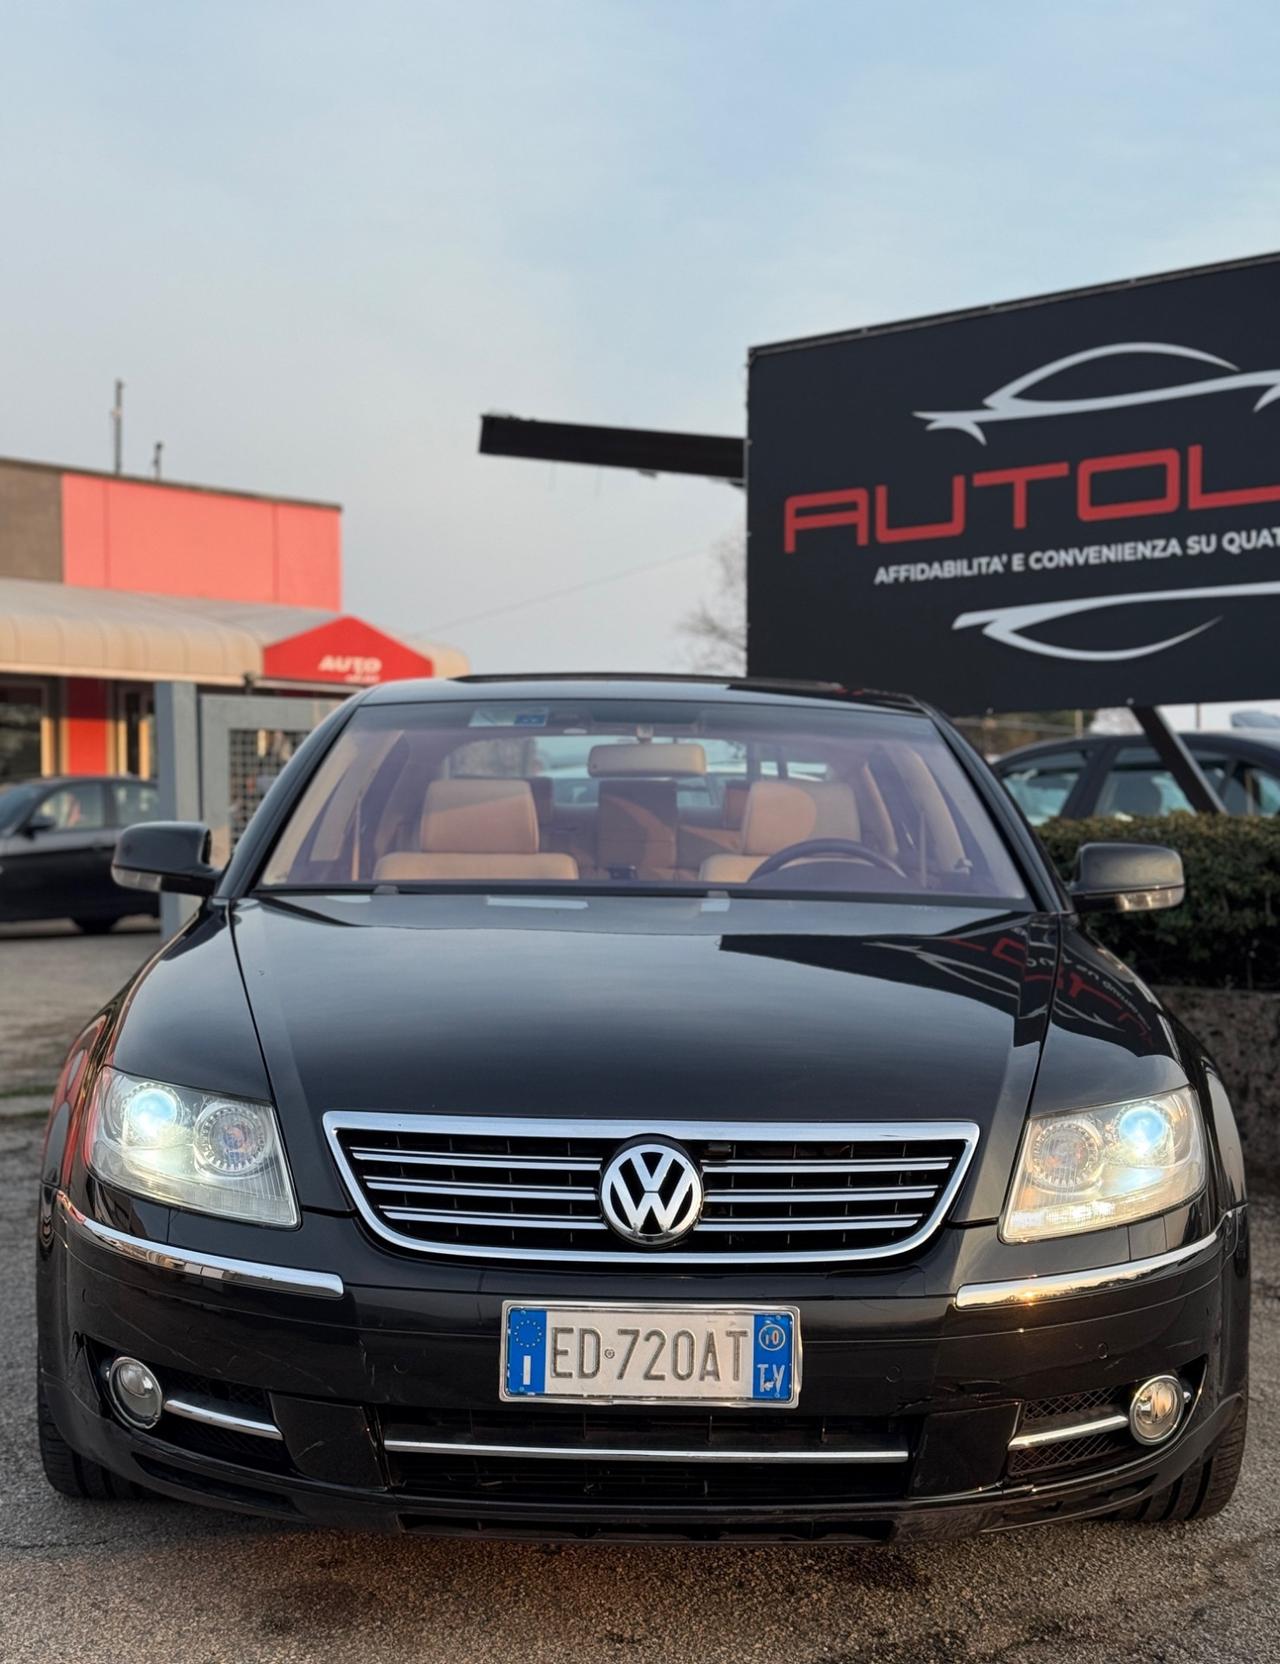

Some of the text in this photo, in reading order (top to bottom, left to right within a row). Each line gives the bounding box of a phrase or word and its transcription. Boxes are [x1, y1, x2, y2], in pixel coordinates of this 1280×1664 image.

[784, 444, 1280, 553] AUTOL
[873, 553, 1008, 585] AFFIDABILITA'
[1011, 553, 1025, 573] E
[1028, 537, 1183, 571] CONVENIENZA
[1186, 533, 1217, 555] SU
[317, 654, 382, 674] AUTO
